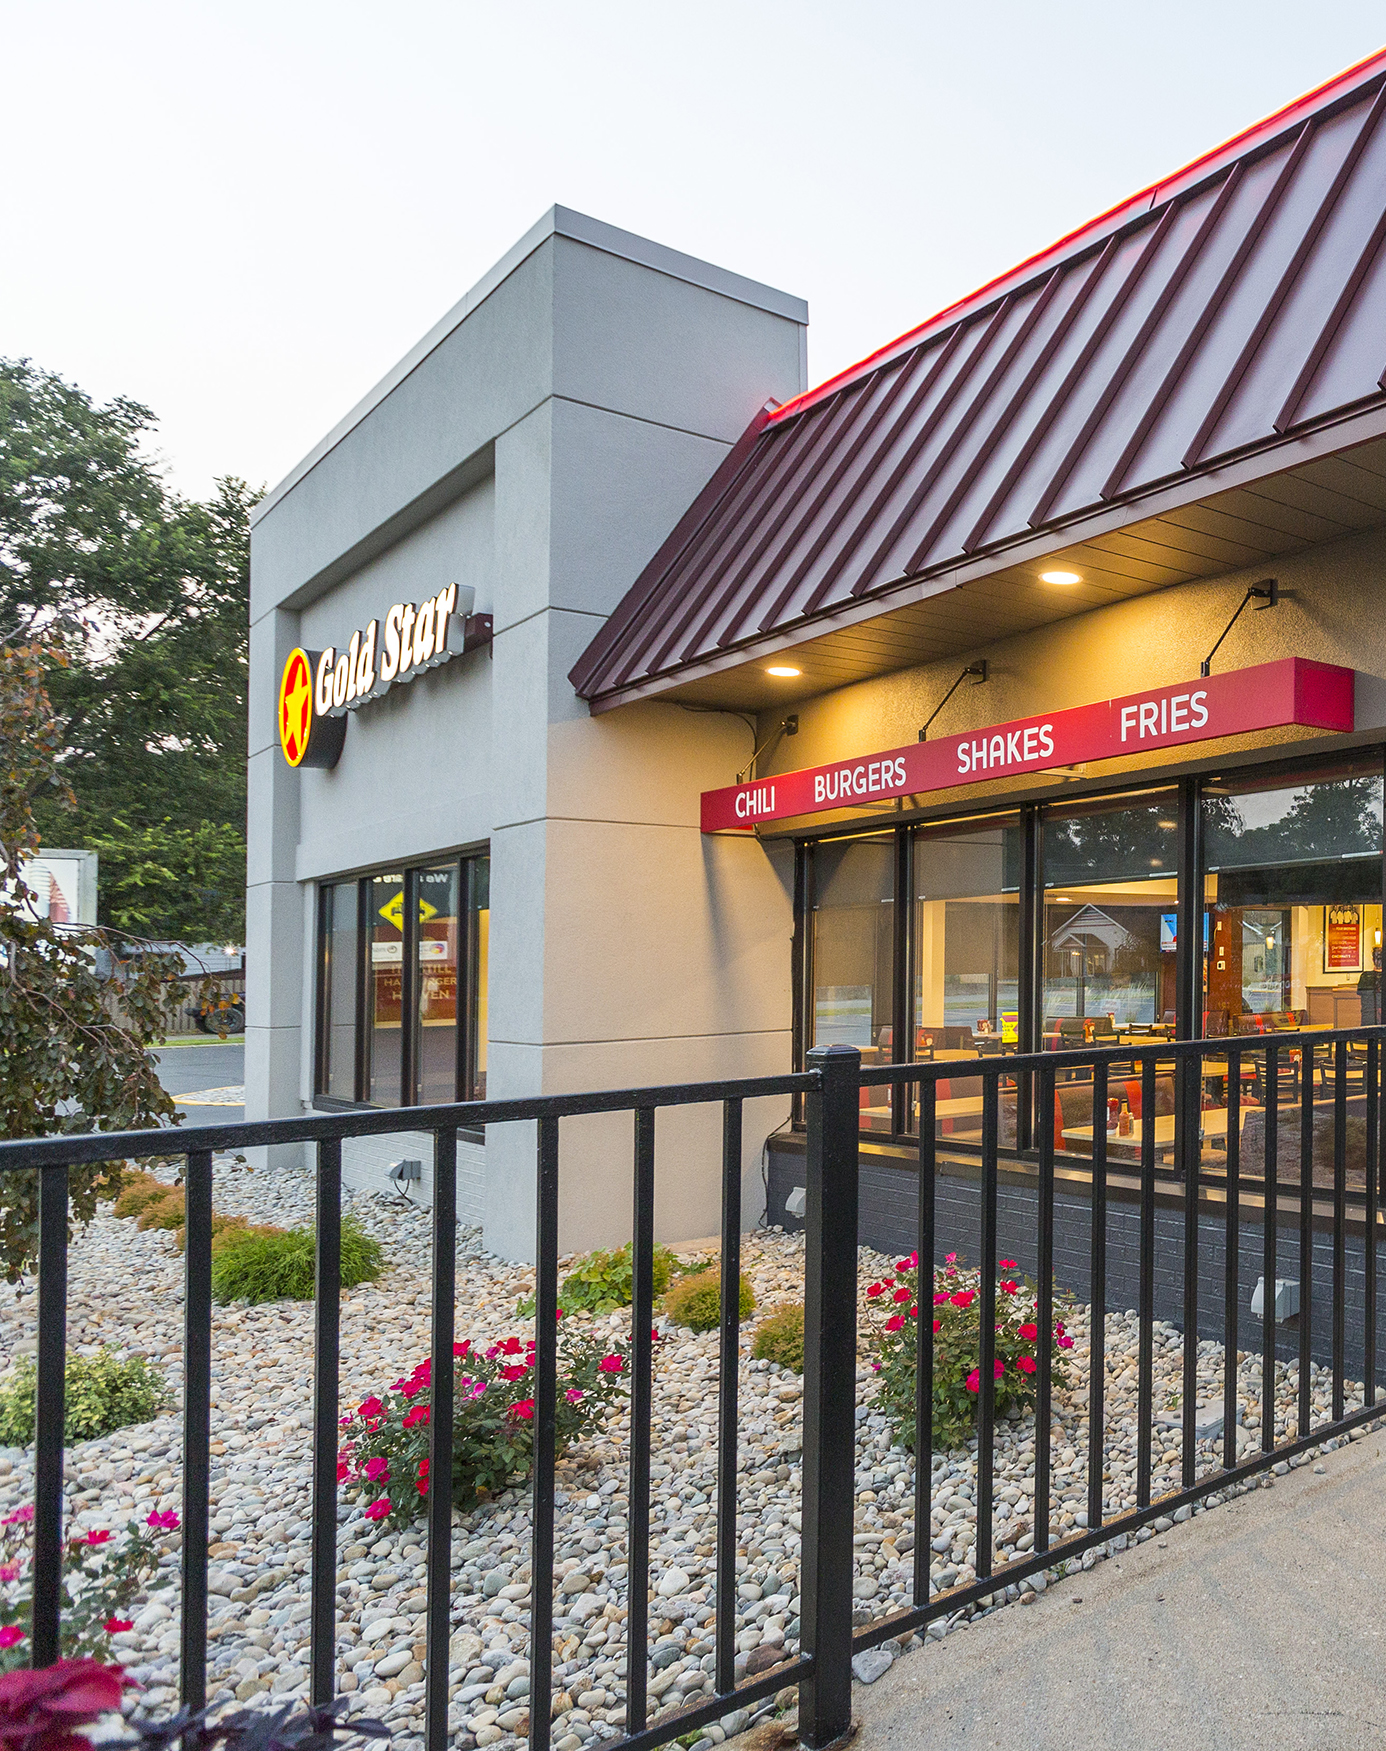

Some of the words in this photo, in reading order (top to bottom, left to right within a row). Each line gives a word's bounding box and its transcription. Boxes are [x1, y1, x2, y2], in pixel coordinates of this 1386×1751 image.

[315, 619, 376, 716] Gold
[380, 582, 457, 682] Star
[735, 786, 775, 818] CHILI
[815, 757, 907, 803] BURGERS
[957, 724, 1055, 774] SHAKES
[1120, 691, 1209, 742] FRIES
